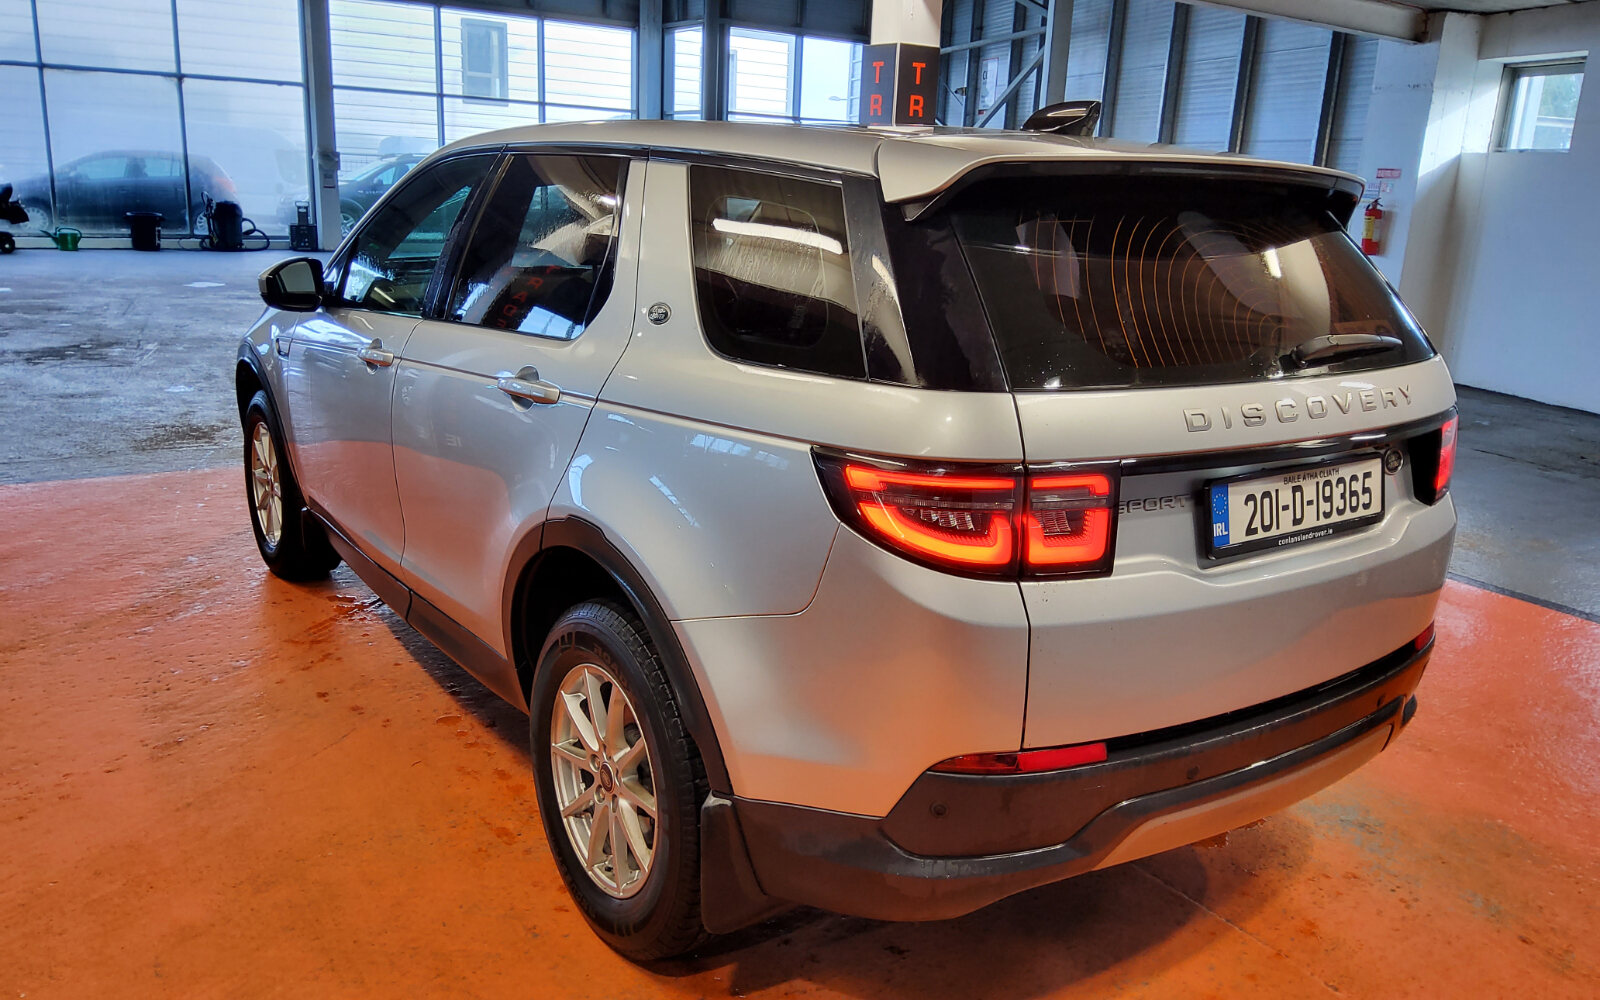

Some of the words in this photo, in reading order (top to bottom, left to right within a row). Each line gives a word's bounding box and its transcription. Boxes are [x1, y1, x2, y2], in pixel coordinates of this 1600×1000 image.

[1183, 384, 1413, 433] DISCOVERY
[1283, 474, 1301, 485] BAILE
[1320, 467, 1340, 479] CLIATH
[1244, 471, 1373, 537] 201-D-19365
[1213, 523, 1229, 538] IRL
